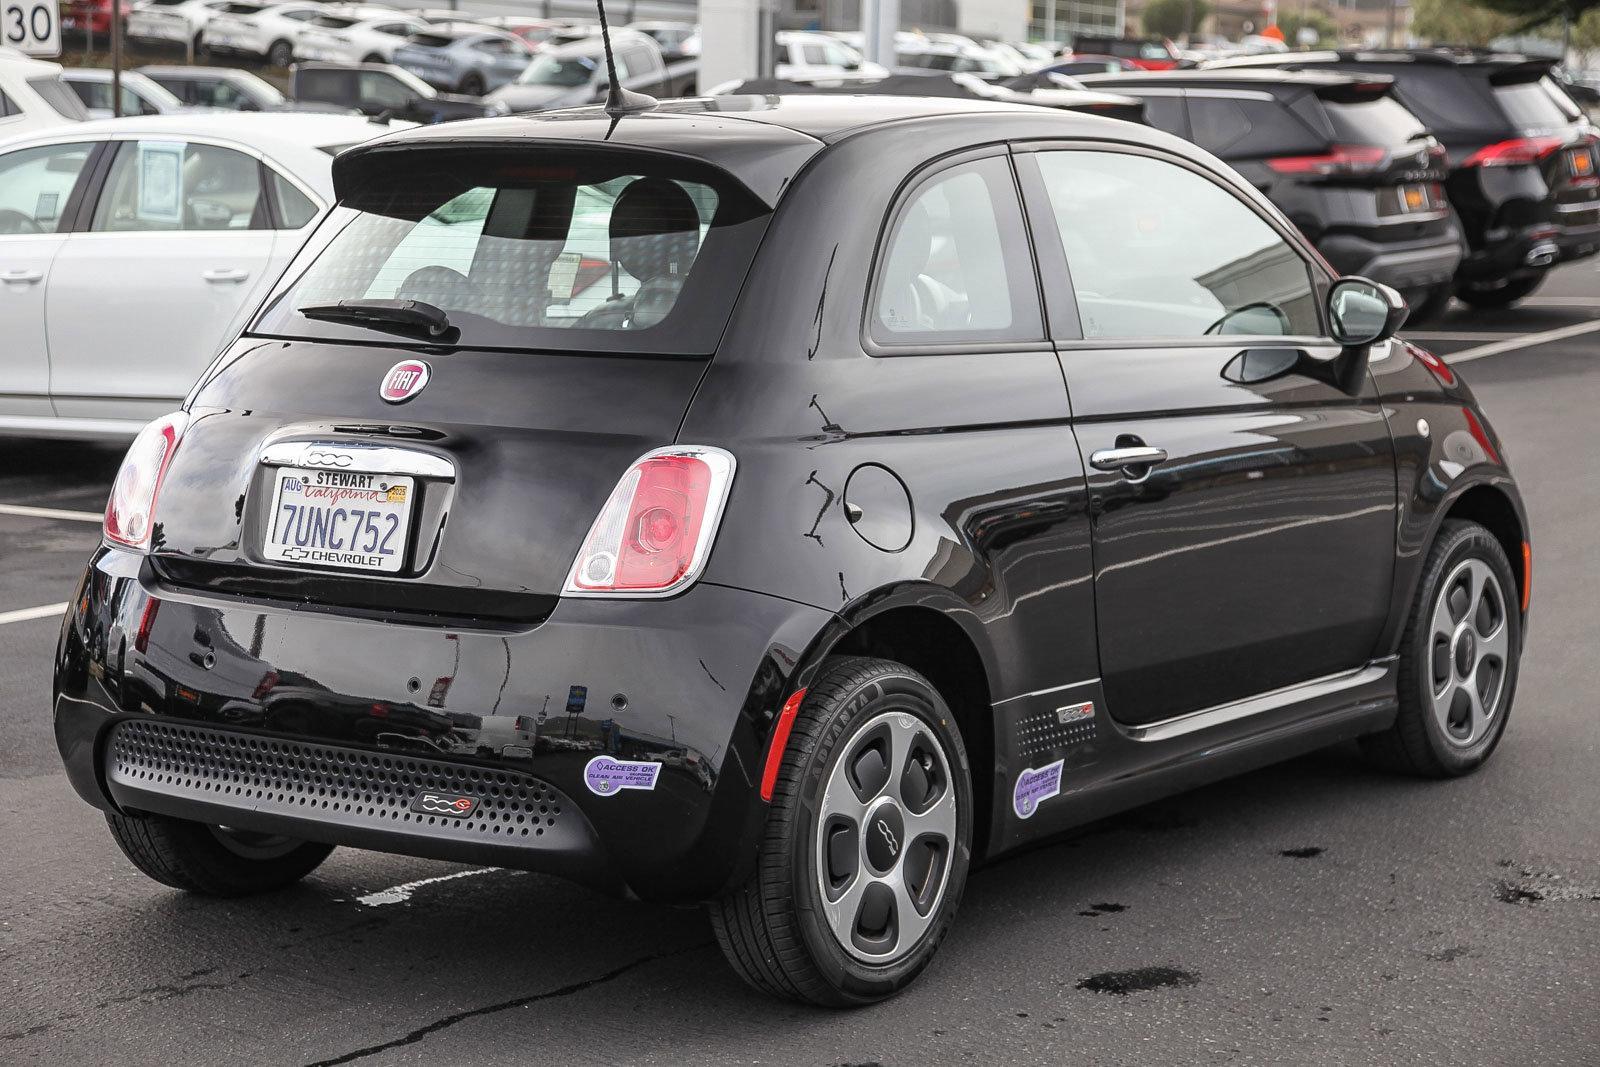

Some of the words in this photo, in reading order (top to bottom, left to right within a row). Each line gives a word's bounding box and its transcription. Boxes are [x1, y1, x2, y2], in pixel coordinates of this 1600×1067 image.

[7, 6, 51, 42] 30
[388, 370, 421, 390] FIAT
[307, 452, 354, 467] 500
[284, 478, 302, 492] AUG
[316, 471, 375, 489] STEWART
[304, 485, 388, 506] California
[391, 487, 407, 497] 2025
[281, 504, 400, 556] 7UNC752
[311, 550, 385, 567] CHEVROLET
[812, 692, 870, 781] ADVANTA
[603, 764, 639, 772] ACCESS
